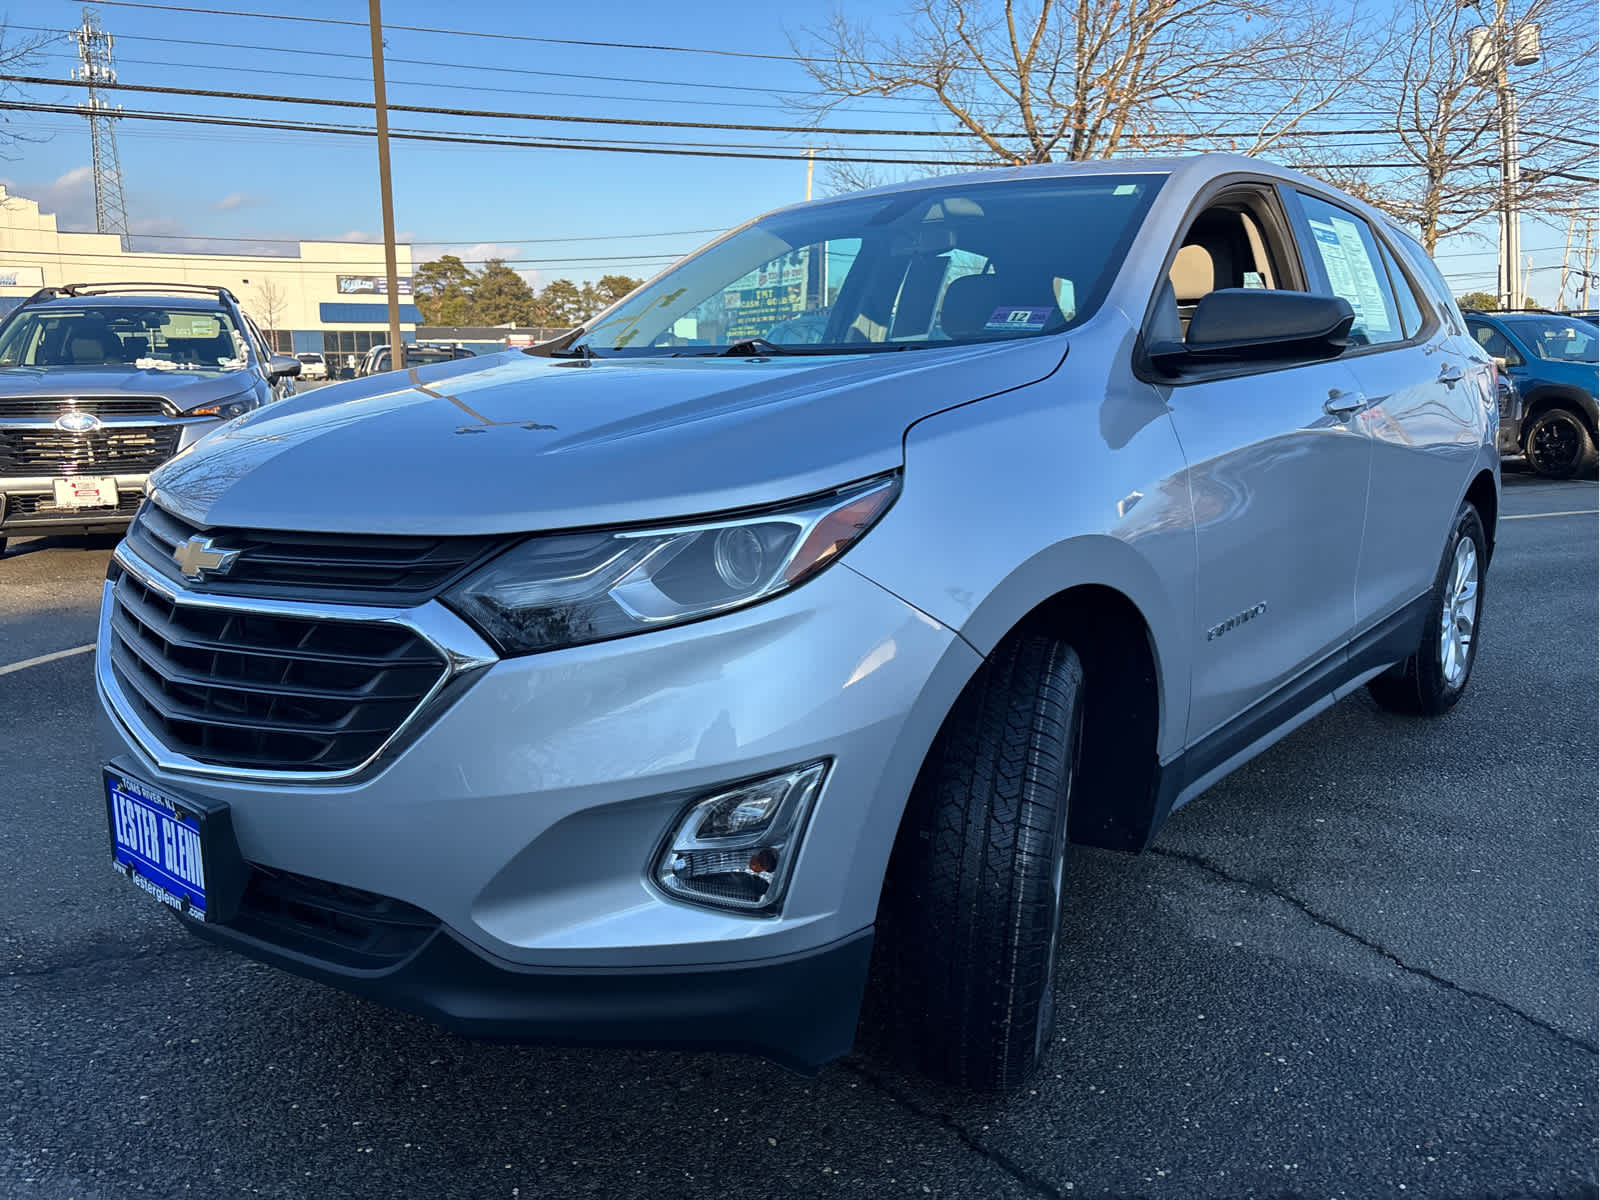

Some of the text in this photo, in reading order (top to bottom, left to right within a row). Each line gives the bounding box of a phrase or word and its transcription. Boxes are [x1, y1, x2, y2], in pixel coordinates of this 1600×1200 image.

[1011, 312, 1029, 322] 12
[122, 777, 142, 796] TOMS
[164, 798, 176, 812] NJ
[112, 792, 206, 890] LESTER GLENN
[132, 869, 182, 912] lesterglenn
